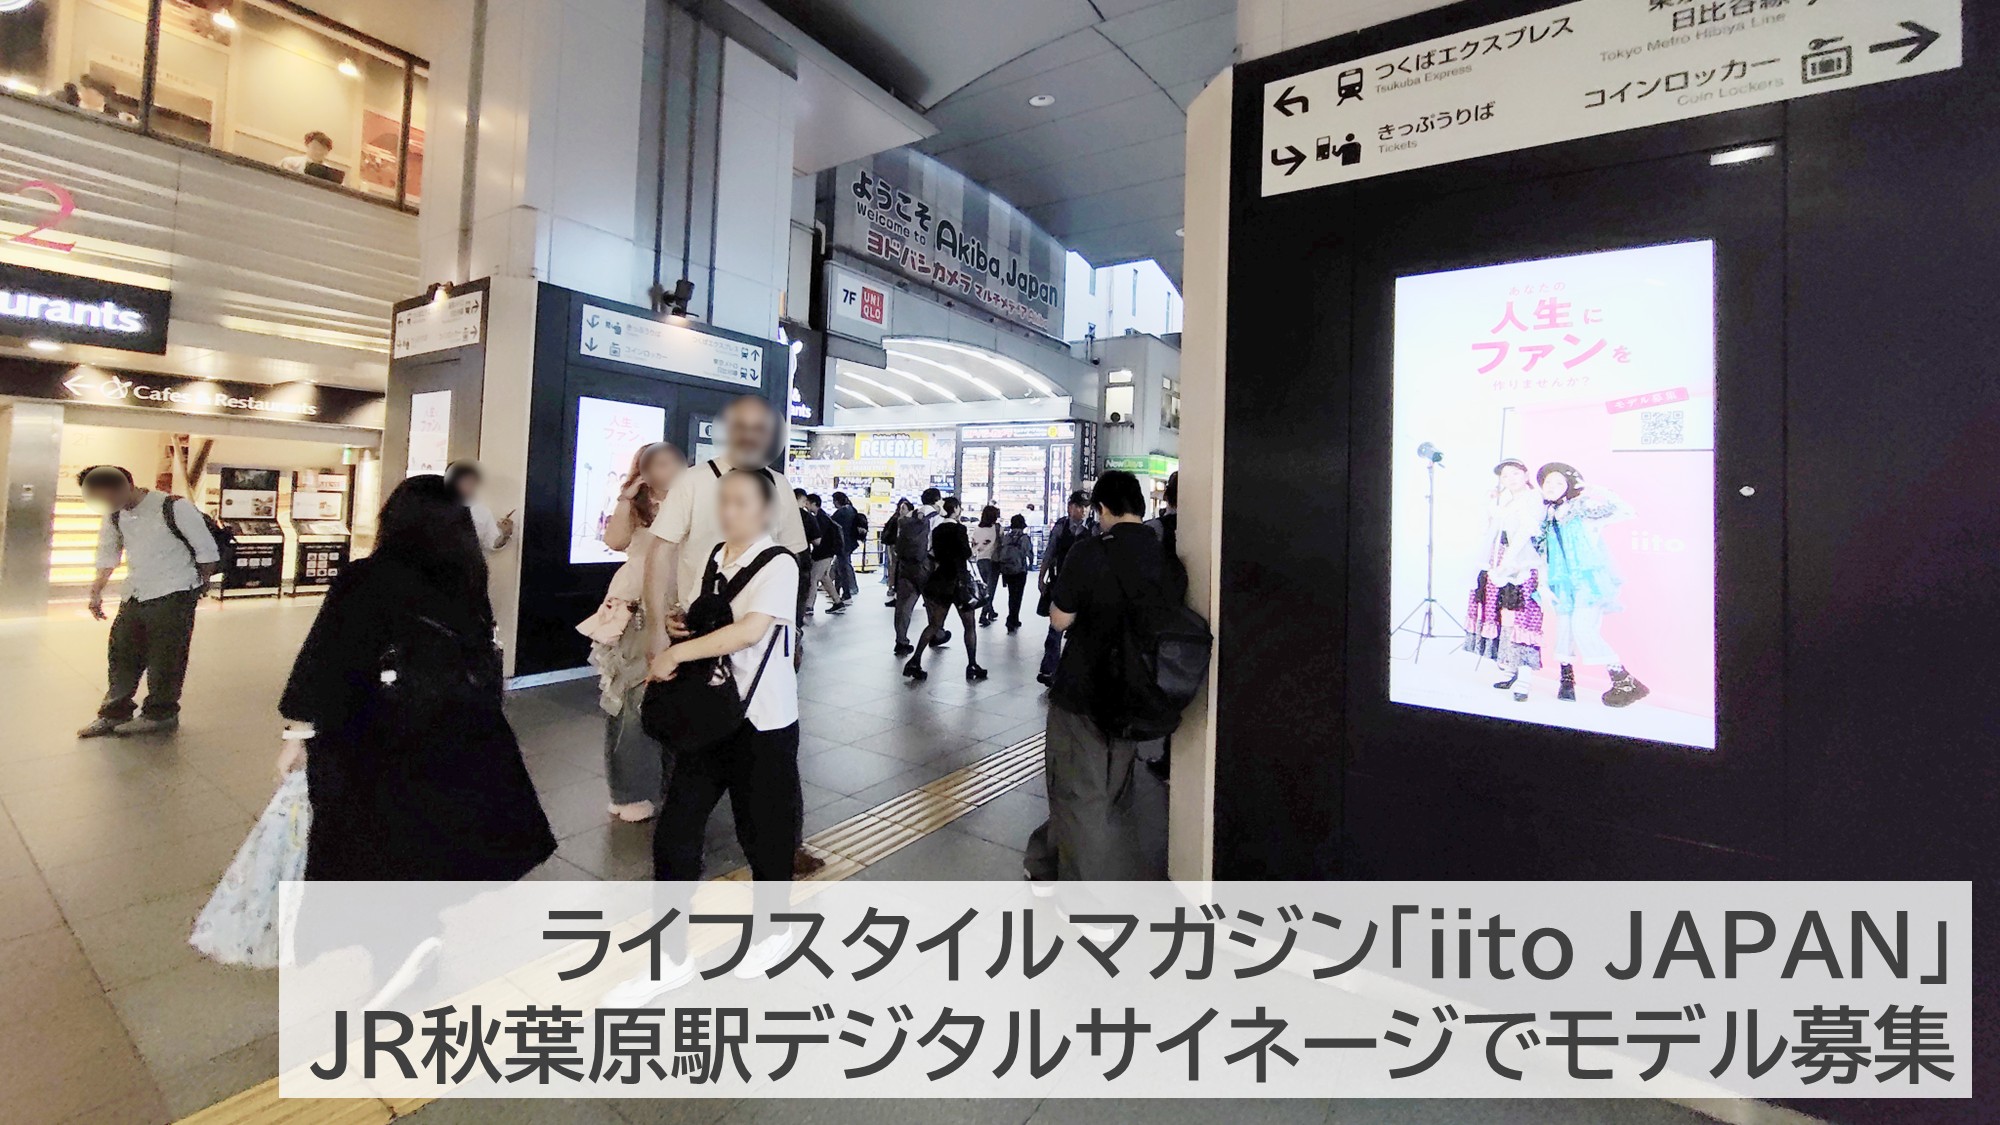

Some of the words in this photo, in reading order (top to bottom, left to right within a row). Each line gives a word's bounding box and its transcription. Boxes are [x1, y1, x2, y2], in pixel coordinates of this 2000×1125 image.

[1375, 16, 1574, 80] つくばエクスプレス
[1600, 47, 1642, 62] Tokyo
[1647, 35, 1690, 52] Metro
[1696, 21, 1745, 40] Hibiya
[1751, 12, 1786, 28] Line
[1375, 77, 1421, 94] Tsukuba
[1424, 64, 1473, 83] Express
[1584, 58, 1781, 109] コインロッカー
[1677, 91, 1714, 107] Coin
[1719, 77, 1784, 98] Lockers
[1378, 101, 1496, 141] きっぷうりば
[1378, 140, 1418, 154] Tickets
[11, 179, 77, 253] 2
[853, 171, 932, 232] ようこそ
[856, 201, 910, 238] Welcome
[914, 230, 927, 246] to
[867, 230, 973, 294] ヨドバシカメラ
[974, 283, 1028, 319] マルチメディア
[1508, 281, 1566, 297] あなたの
[842, 288, 858, 306] 7F
[863, 292, 882, 306] UNI
[863, 304, 882, 321] QLO
[133, 385, 192, 404] Cafes
[214, 393, 318, 416] Restaurants
[860, 439, 923, 458] RELEASE
[1631, 529, 1686, 553] iito
